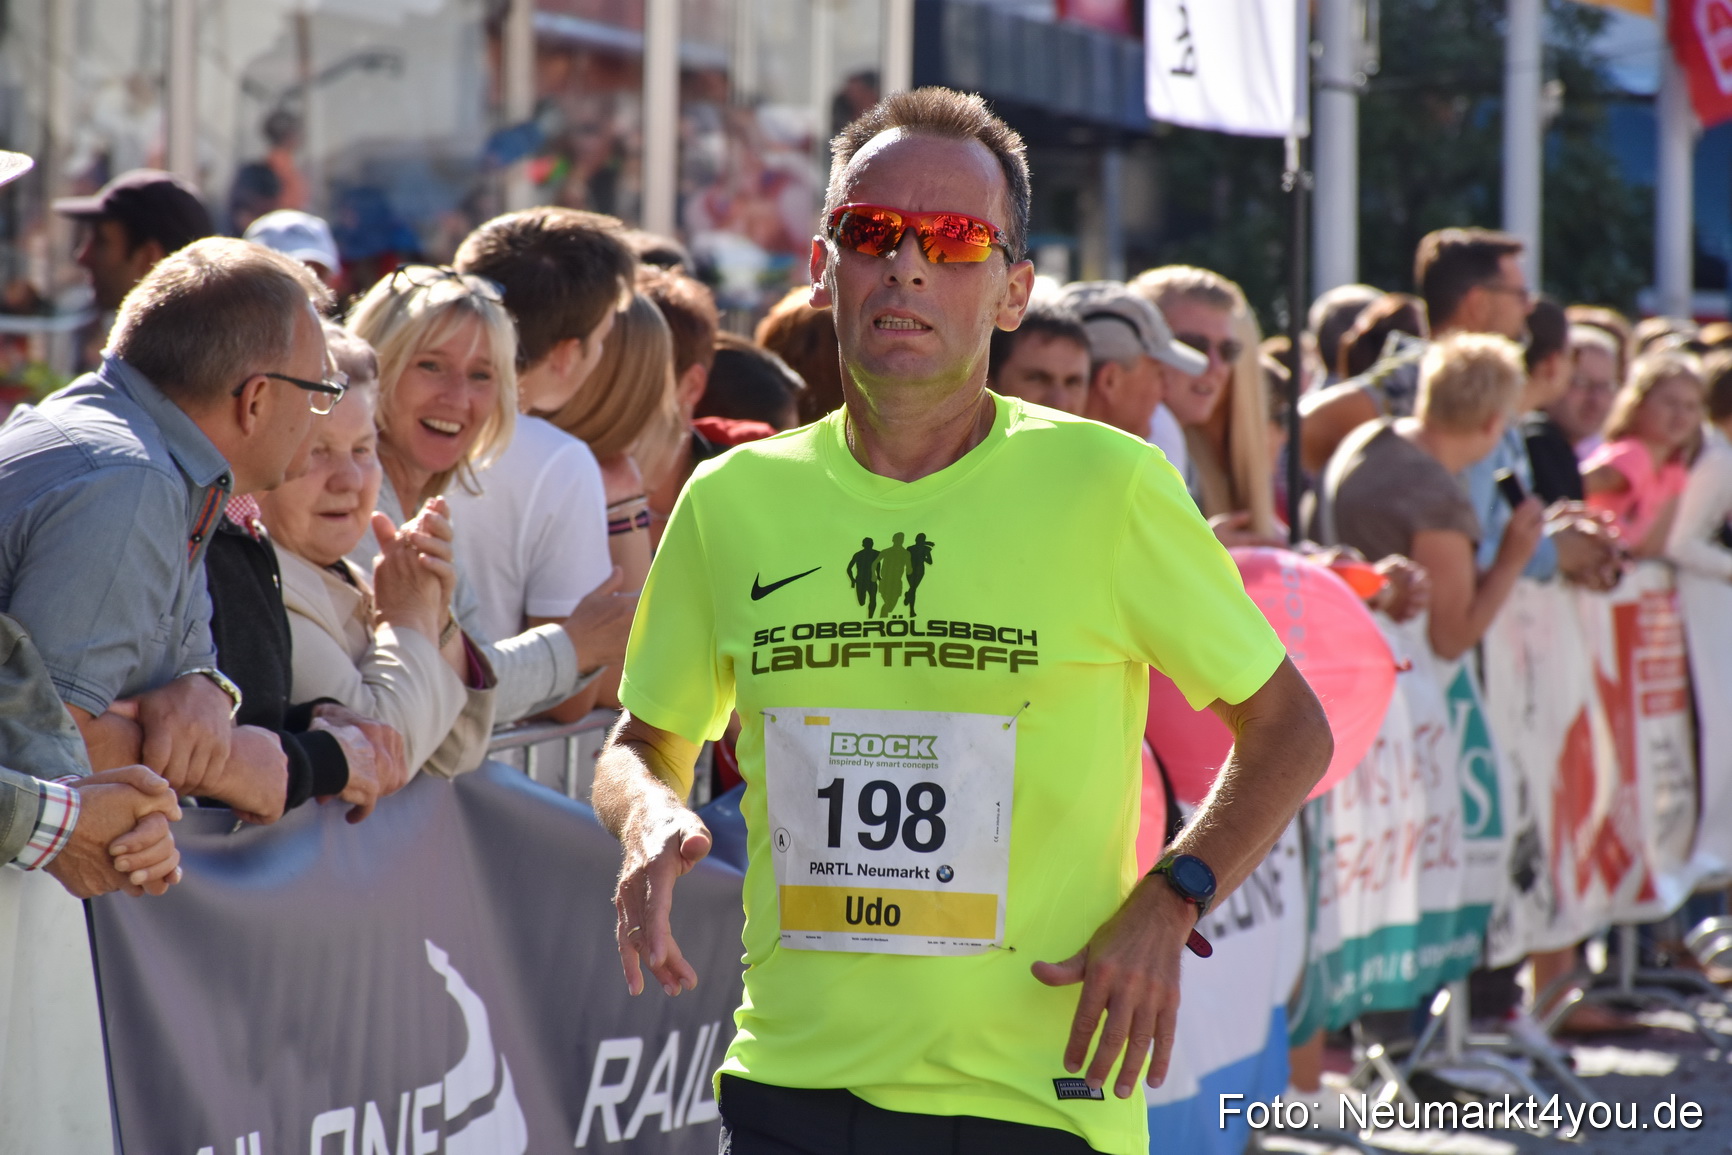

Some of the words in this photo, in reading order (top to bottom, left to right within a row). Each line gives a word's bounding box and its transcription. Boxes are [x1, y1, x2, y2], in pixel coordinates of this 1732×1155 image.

[753, 626, 786, 647] SC
[830, 732, 939, 760] BOCK
[829, 757, 862, 767] inspired
[863, 759, 874, 768] by
[876, 760, 900, 768] smart
[902, 761, 939, 770] concepts
[817, 777, 947, 853] 198
[779, 834, 785, 847] A
[809, 861, 853, 876] PARTL
[857, 863, 930, 880] Neumarkt
[845, 895, 901, 927] Udo
[574, 1021, 720, 1148] RAIL
